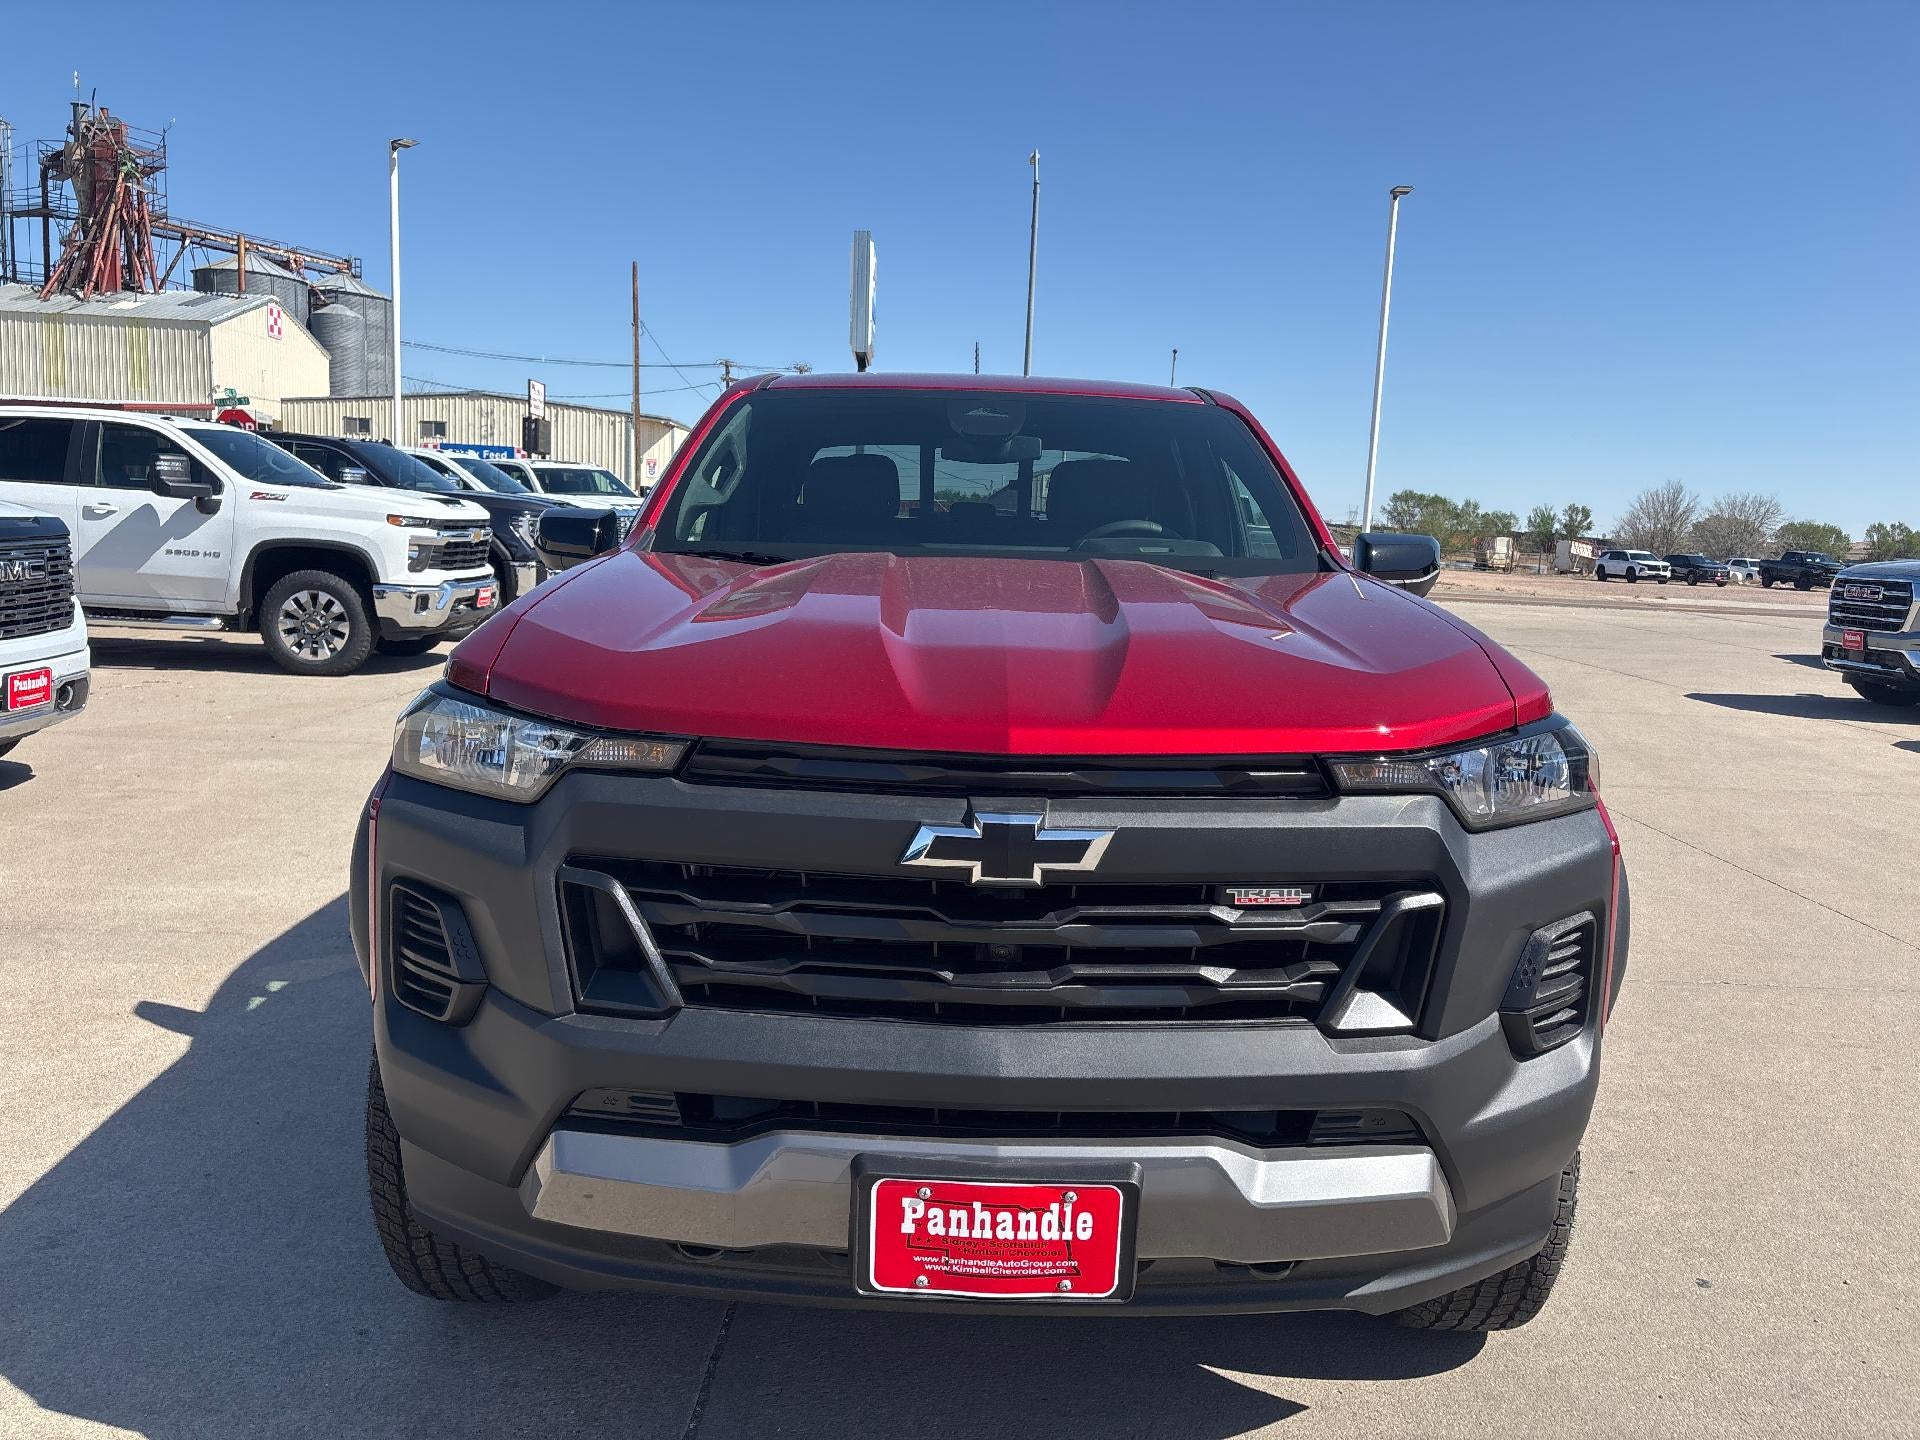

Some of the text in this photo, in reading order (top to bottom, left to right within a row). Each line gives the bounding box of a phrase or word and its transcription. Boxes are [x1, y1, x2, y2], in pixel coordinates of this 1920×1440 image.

[482, 450, 508, 459] Feed
[1846, 585, 1880, 599] GMC
[1226, 888, 1312, 899] TRAIL
[901, 1197, 1094, 1241] Panhandle
